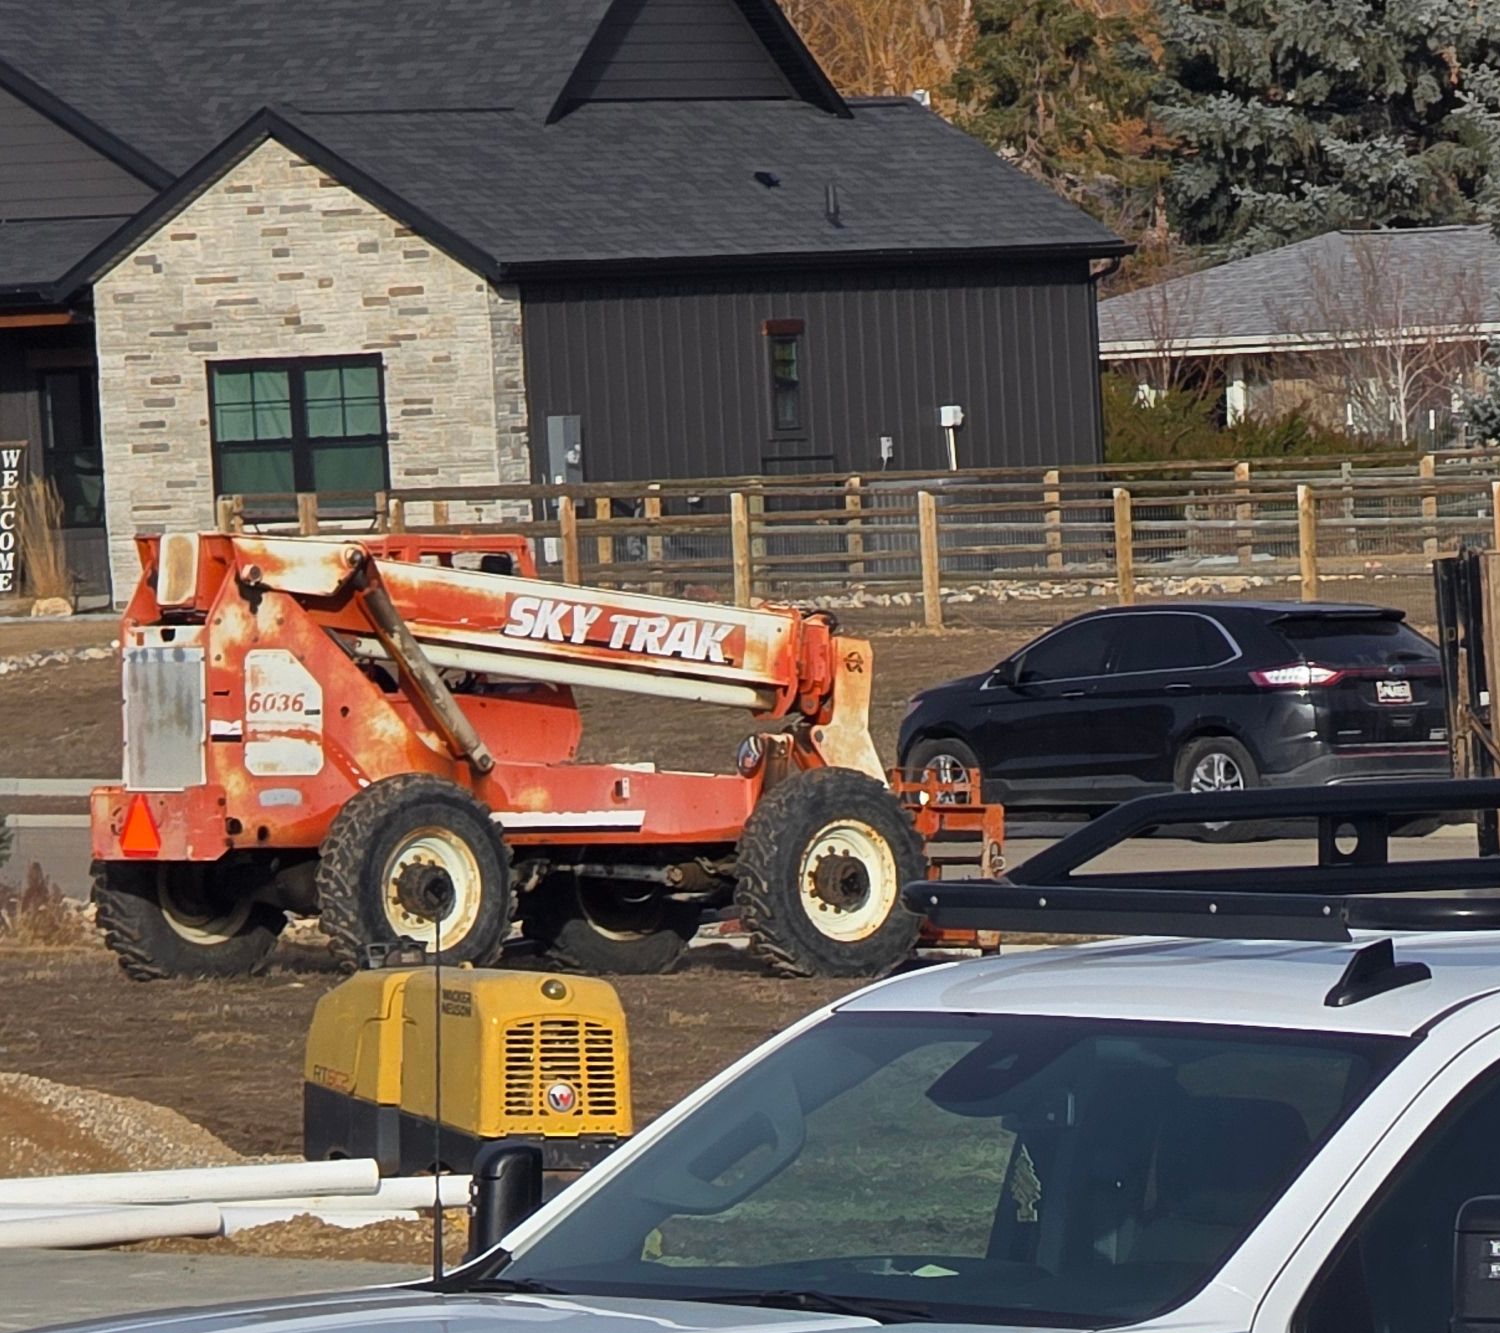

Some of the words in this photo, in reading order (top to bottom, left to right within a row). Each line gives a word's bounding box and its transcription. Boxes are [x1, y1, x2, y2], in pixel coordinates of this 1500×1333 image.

[0, 449, 21, 592] WELCOME
[503, 596, 603, 644] SKY
[609, 613, 736, 663] TRAK
[249, 692, 305, 713] 6036
